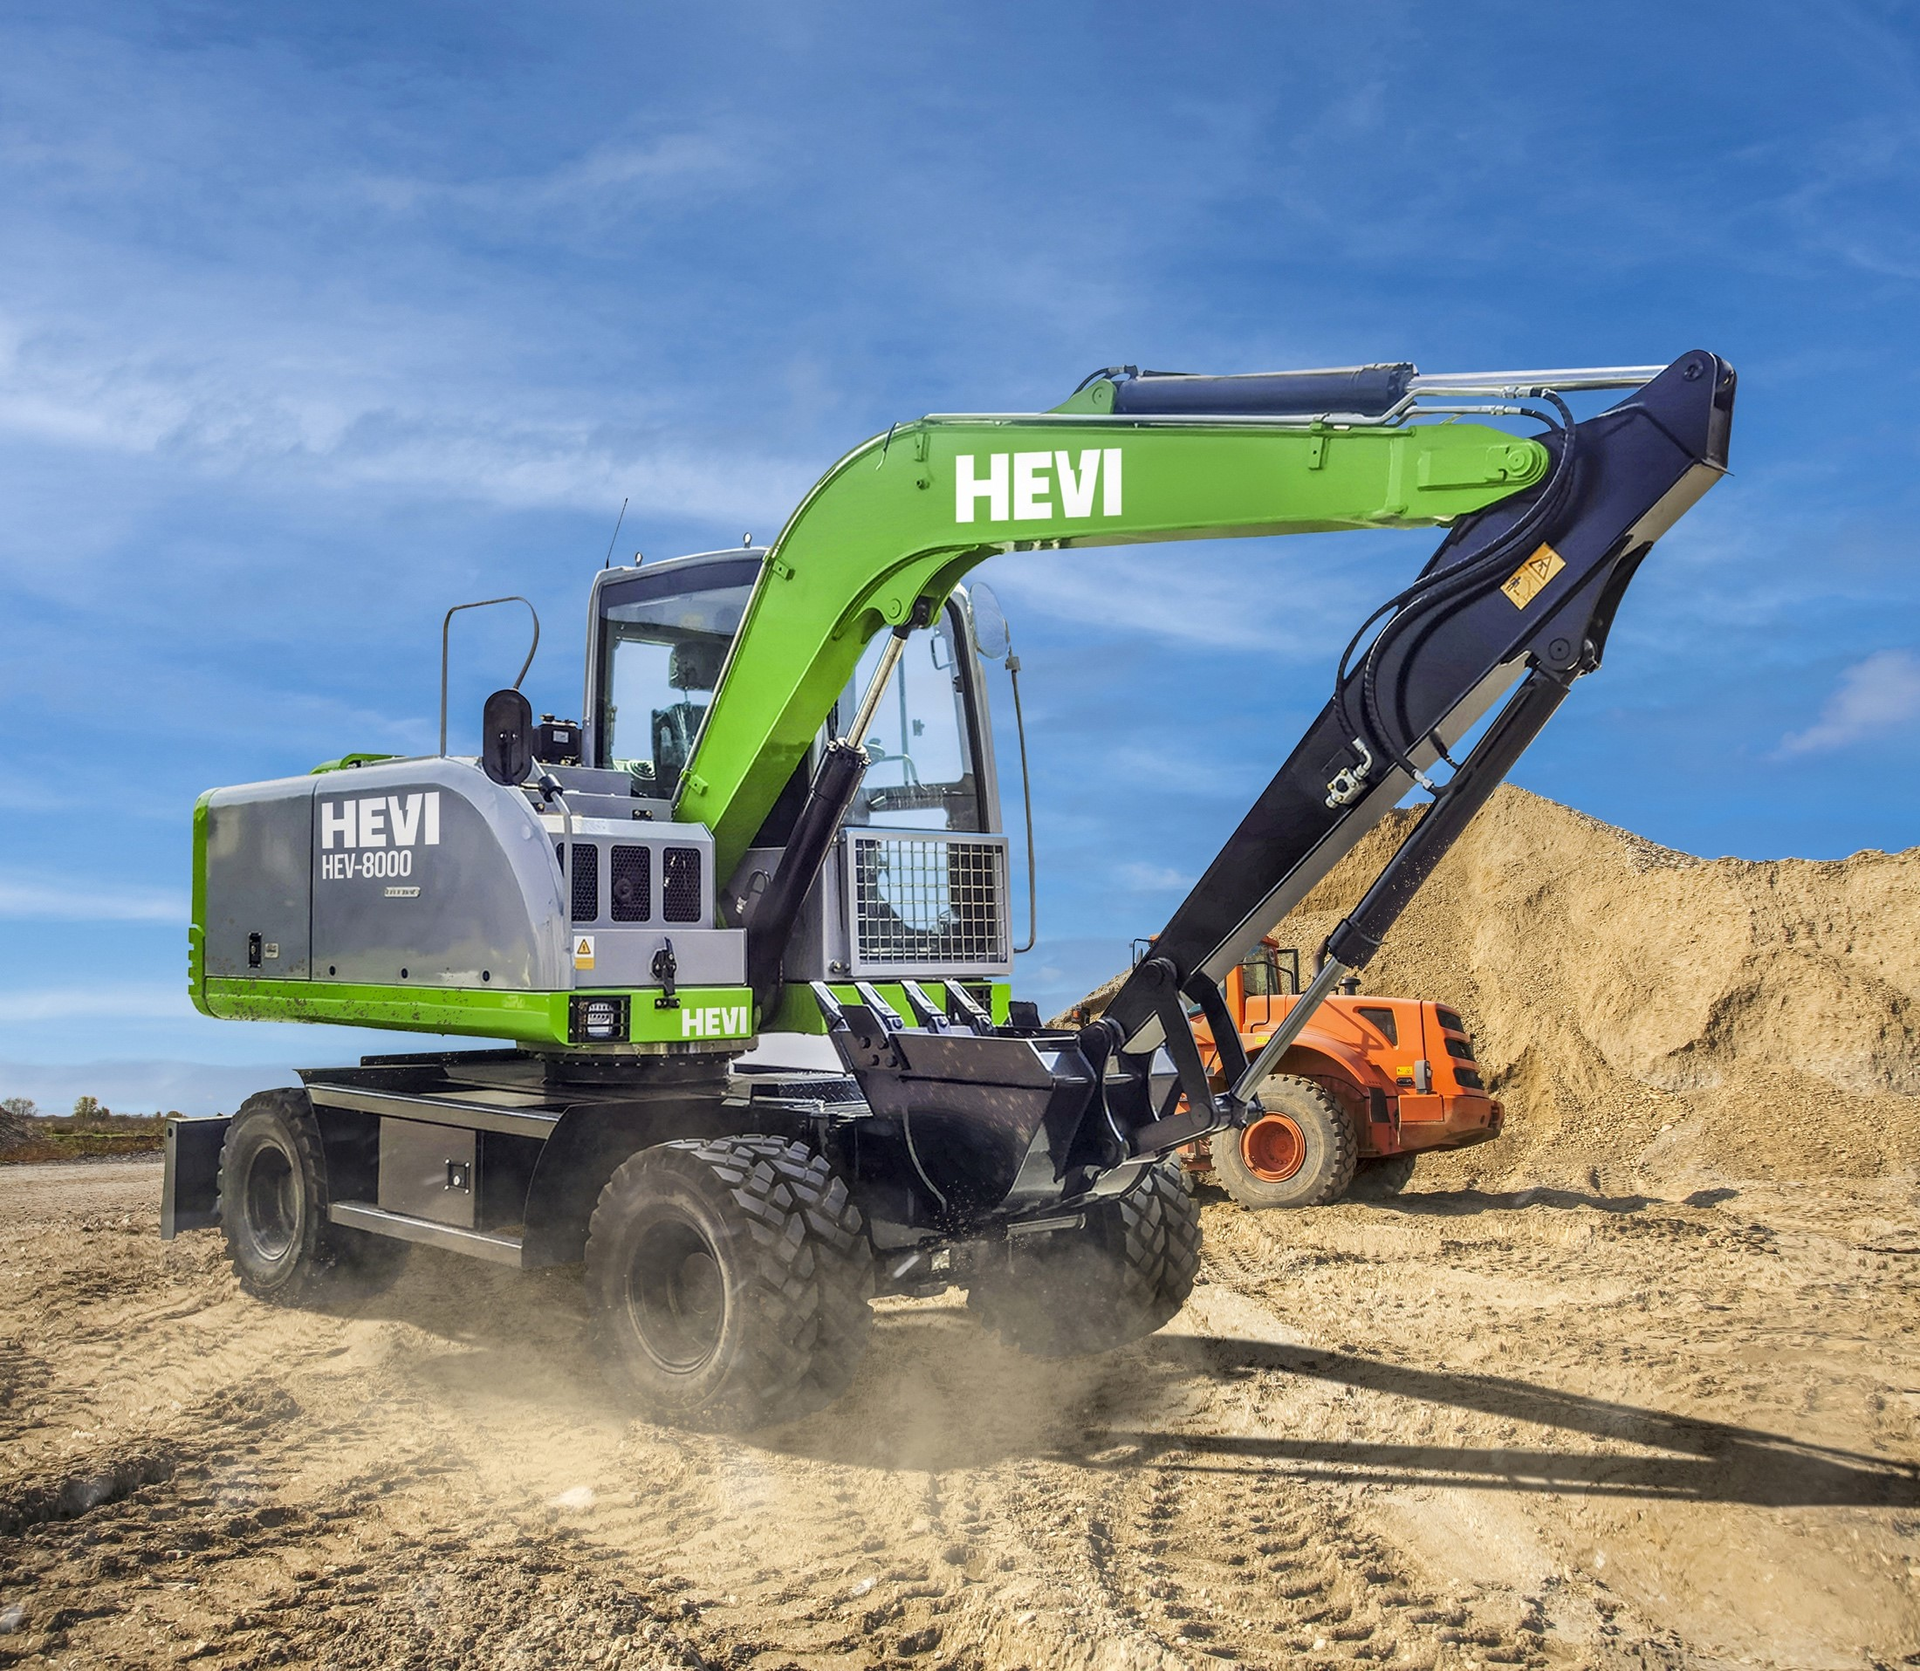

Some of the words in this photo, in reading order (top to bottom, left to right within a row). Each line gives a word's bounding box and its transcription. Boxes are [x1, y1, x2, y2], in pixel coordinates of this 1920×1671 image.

[956, 448, 1122, 523] HEVI
[322, 791, 440, 849] HEVI
[322, 850, 412, 880] HEV-8000
[682, 1006, 747, 1037] HEVI
